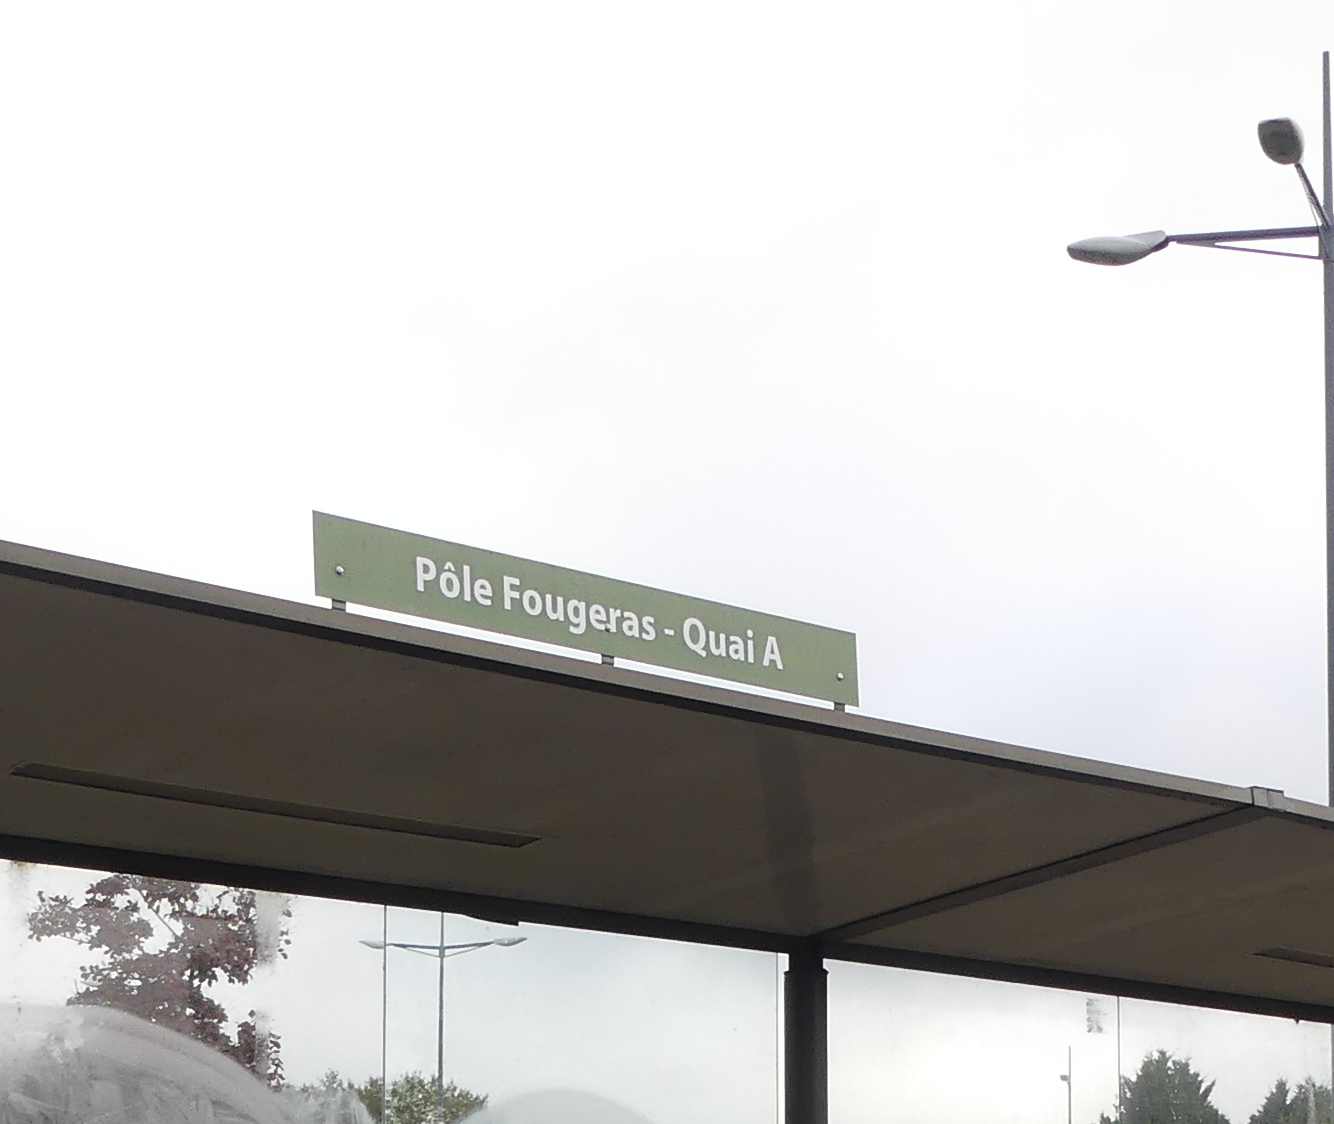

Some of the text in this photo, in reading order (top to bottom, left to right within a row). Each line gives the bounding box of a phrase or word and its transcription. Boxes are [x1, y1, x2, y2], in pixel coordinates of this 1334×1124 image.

[415, 556, 784, 670] Pôle Fougeras - Quai A
